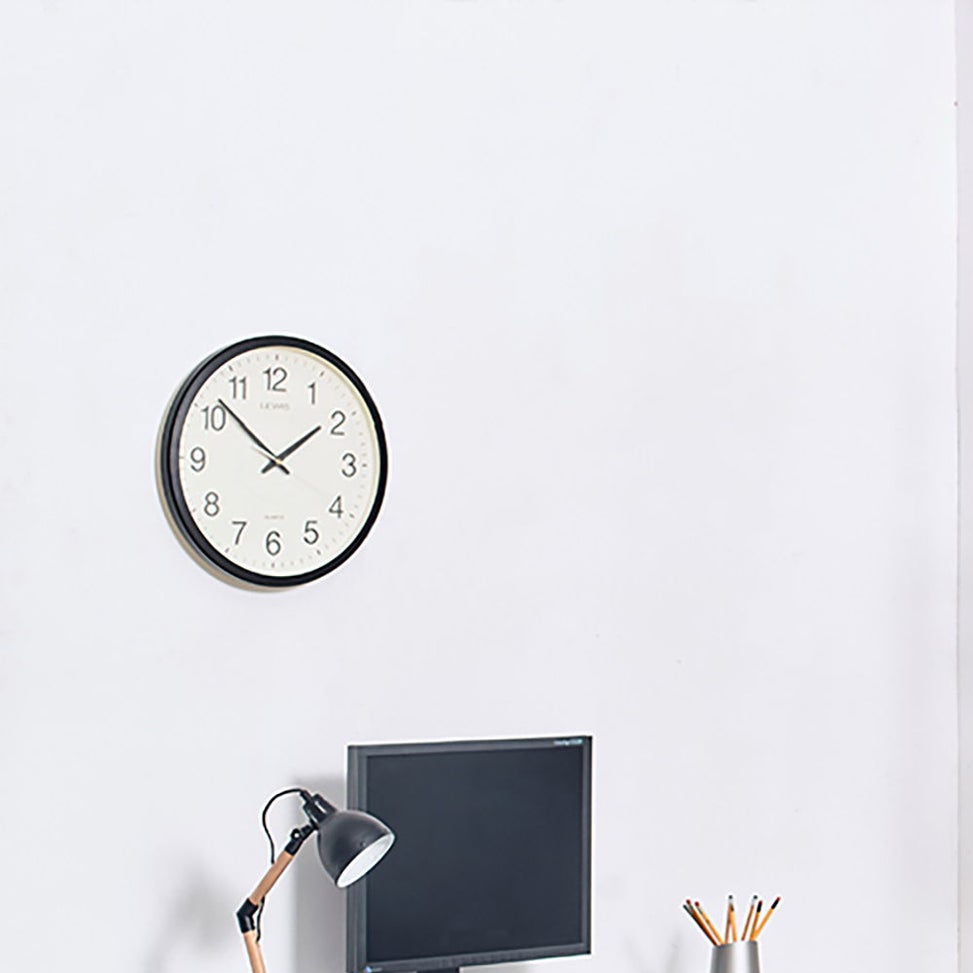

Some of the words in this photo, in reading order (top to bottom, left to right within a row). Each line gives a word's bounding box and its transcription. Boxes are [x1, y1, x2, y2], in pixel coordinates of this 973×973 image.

[228, 375, 247, 400] 11
[262, 366, 288, 393] 12
[308, 381, 317, 405] 1
[201, 405, 226, 431] 10
[330, 410, 347, 436] 2
[190, 446, 206, 473] 9
[341, 452, 357, 478] 3
[203, 491, 220, 518] 8
[328, 495, 345, 519] 4
[231, 520, 248, 546] 7
[265, 530, 282, 557] 6
[303, 520, 320, 546] 5
